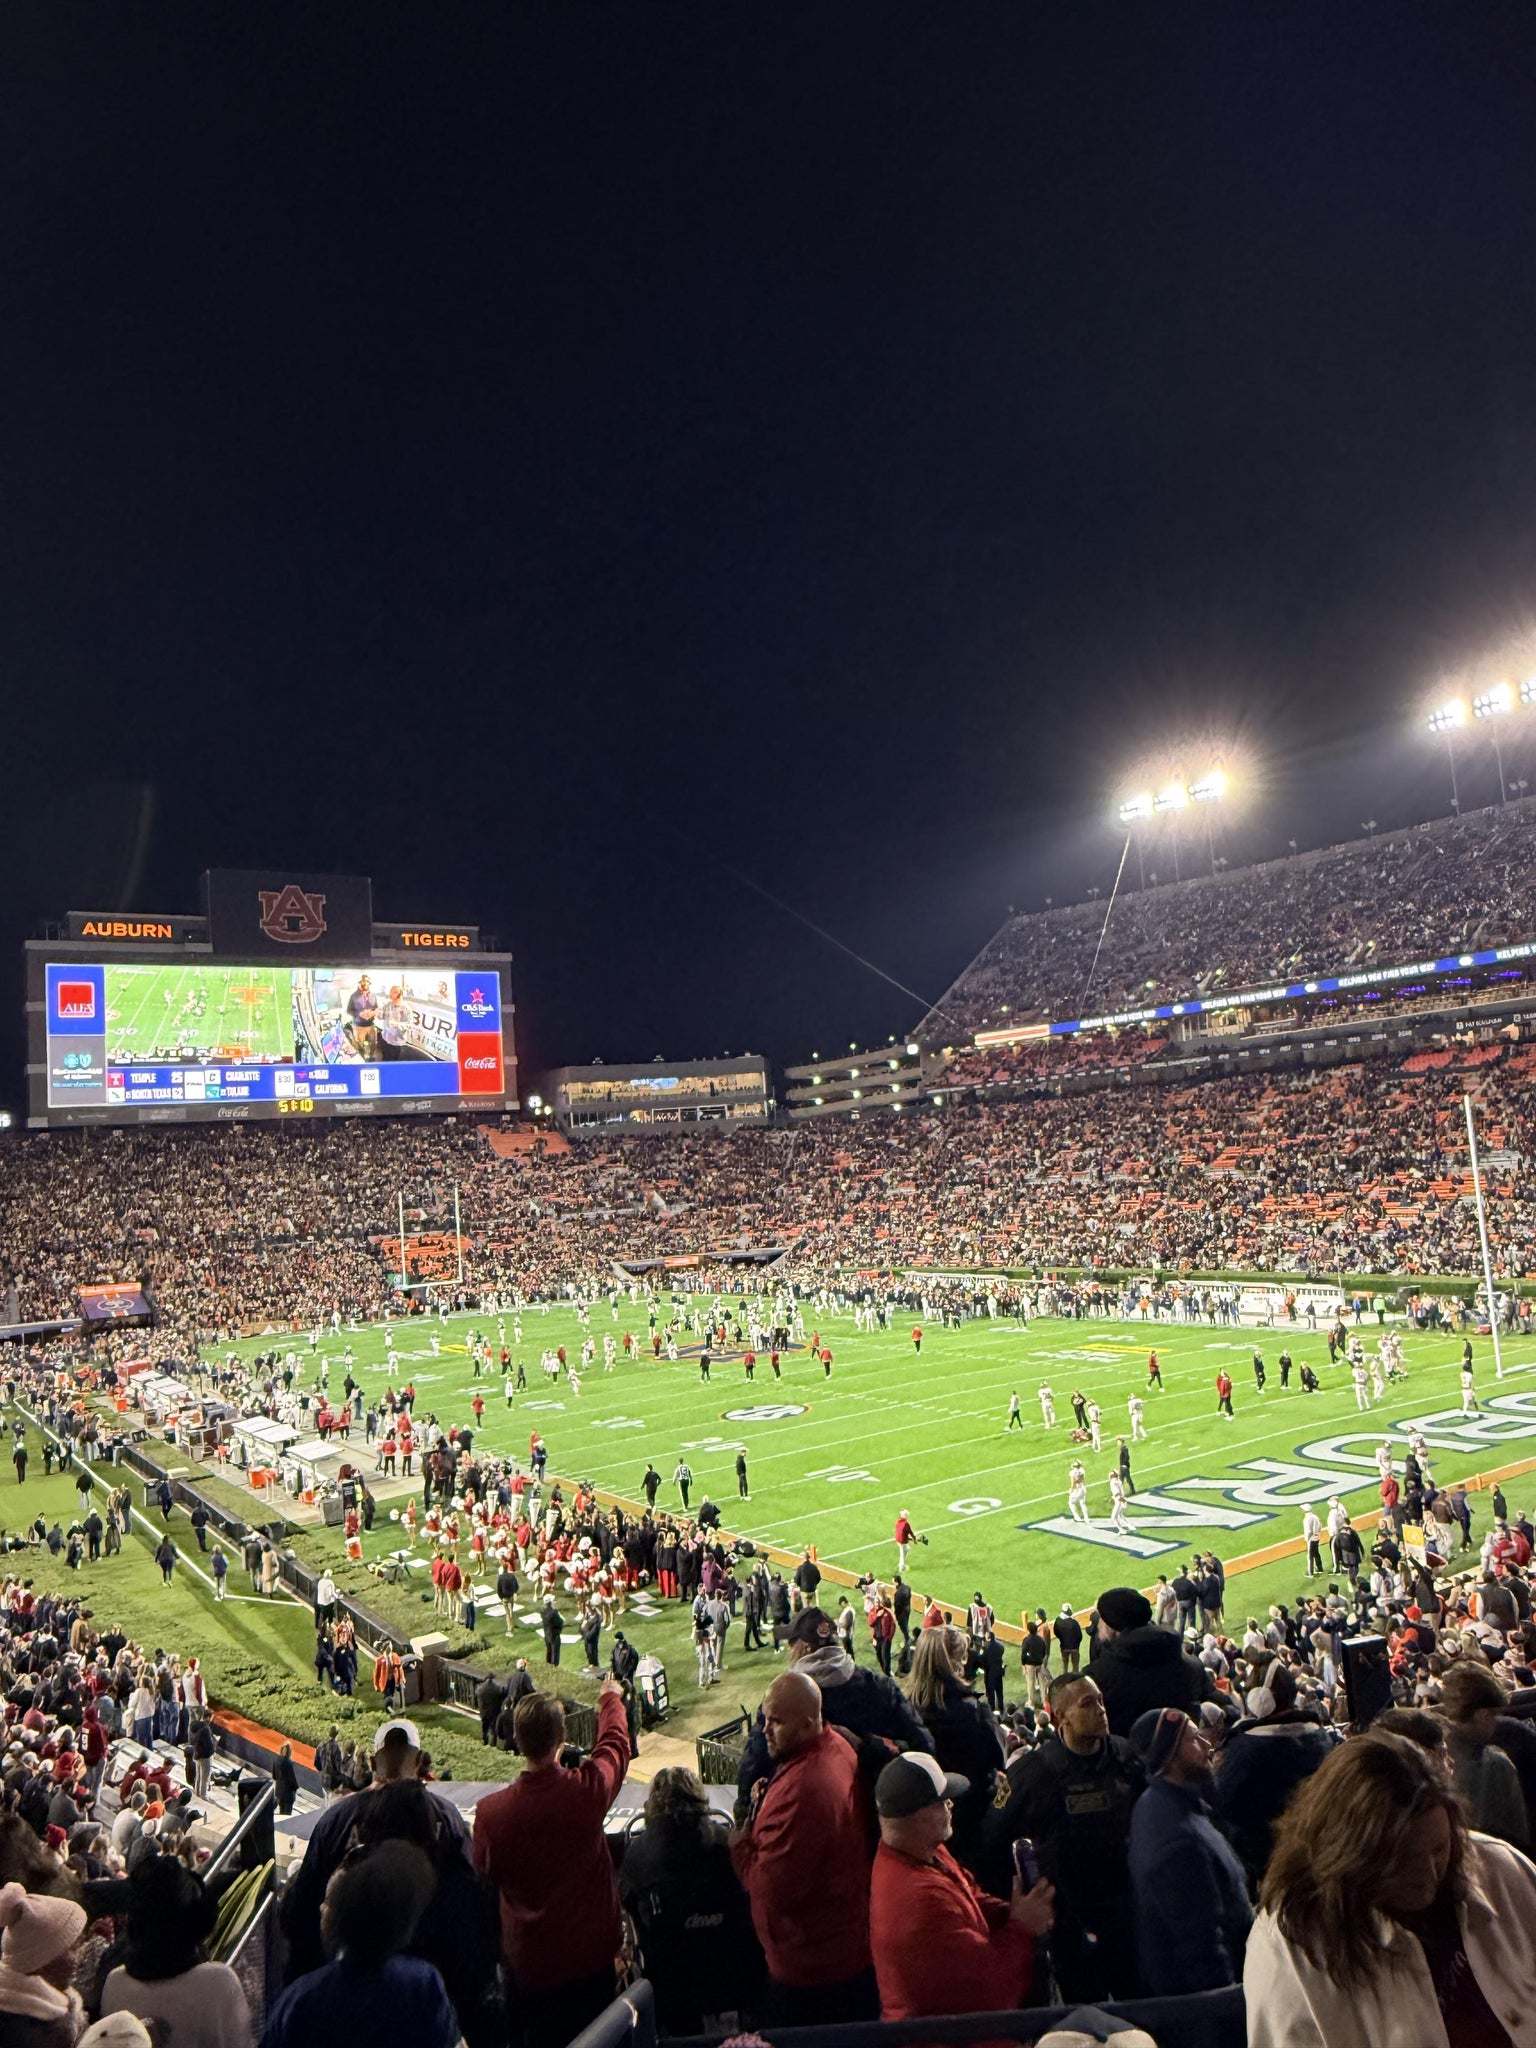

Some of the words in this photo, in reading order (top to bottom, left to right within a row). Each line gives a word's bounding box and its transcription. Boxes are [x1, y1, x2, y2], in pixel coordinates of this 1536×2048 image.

[82, 921, 172, 938] AUBURN
[401, 933, 470, 948] TIGERS
[130, 1073, 157, 1083] TEMPLE
[225, 1071, 260, 1081] CHARLOTTE
[947, 1497, 1002, 1515] G
